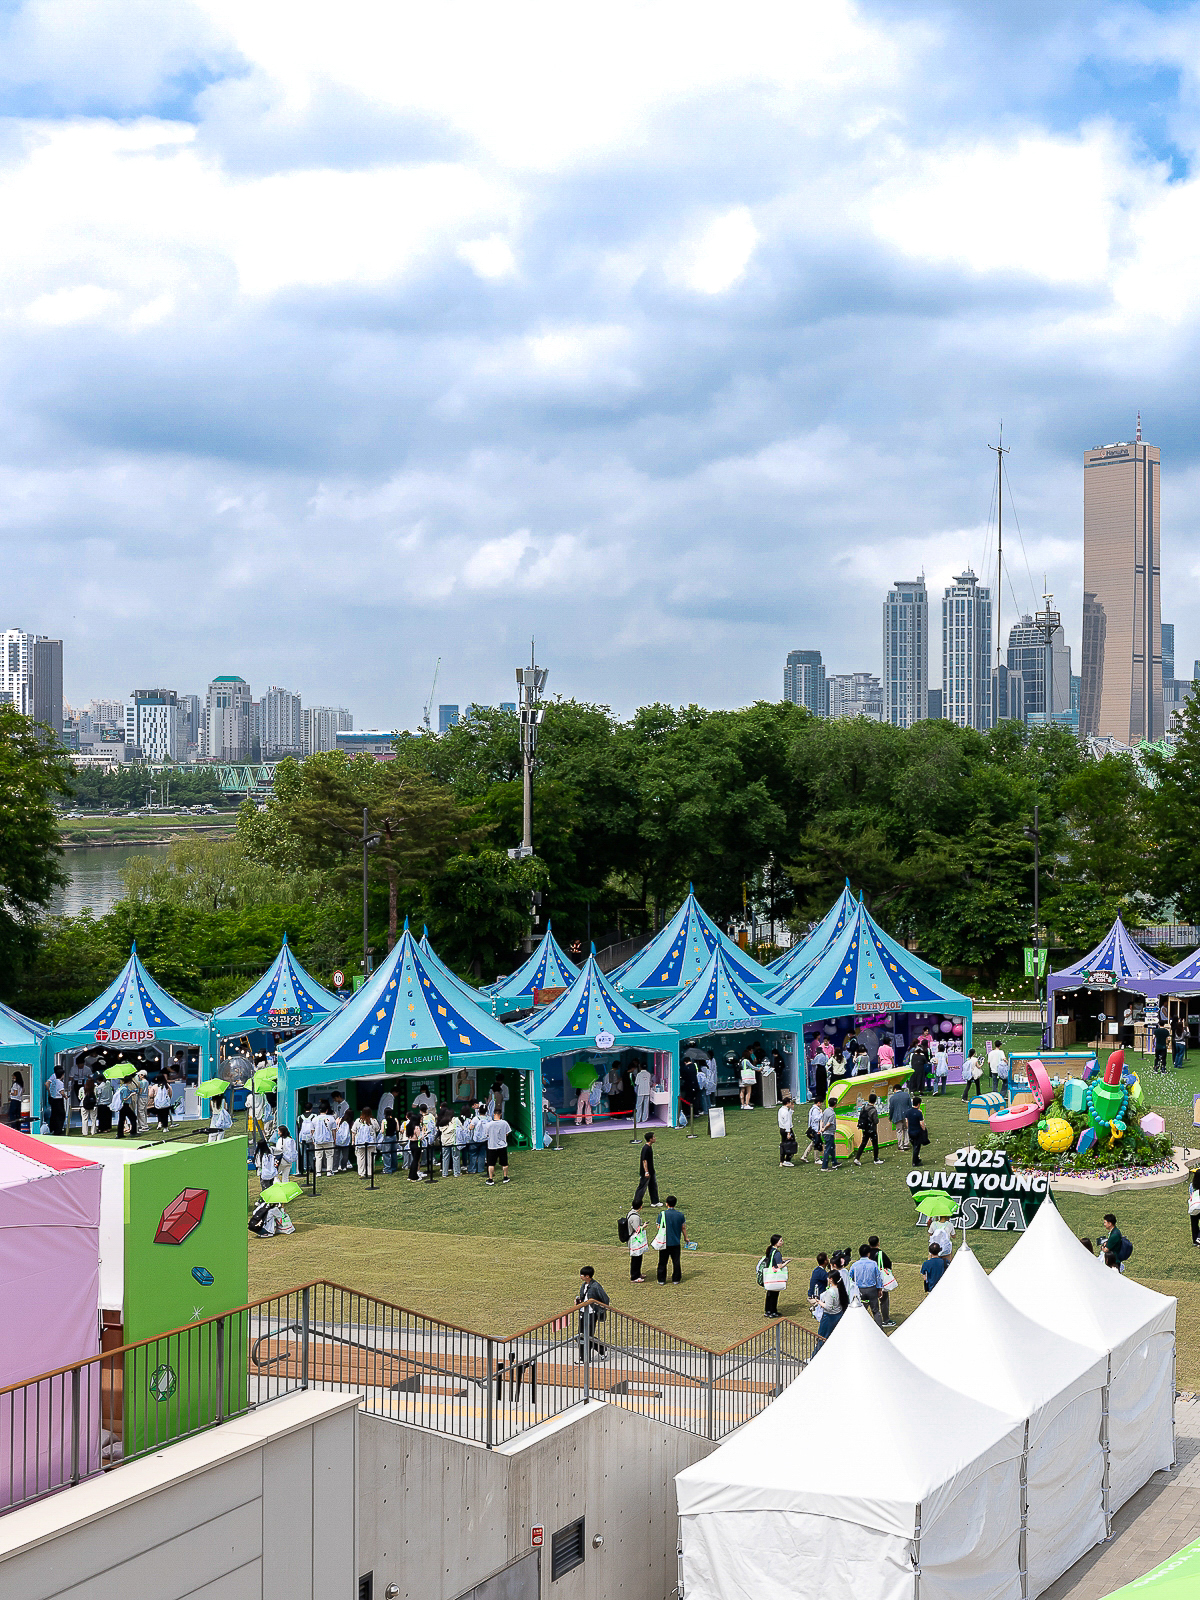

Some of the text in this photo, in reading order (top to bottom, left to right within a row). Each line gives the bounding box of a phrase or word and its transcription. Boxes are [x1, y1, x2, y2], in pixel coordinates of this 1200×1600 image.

[856, 1001, 901, 1012] EUTHYMOL
[268, 1015, 302, 1027] 정관장
[111, 1029, 154, 1042] Denps
[954, 1149, 1007, 1168] 2025
[905, 1170, 1048, 1193] OLIVE YOUNG
[916, 1195, 1028, 1232] ESTA
